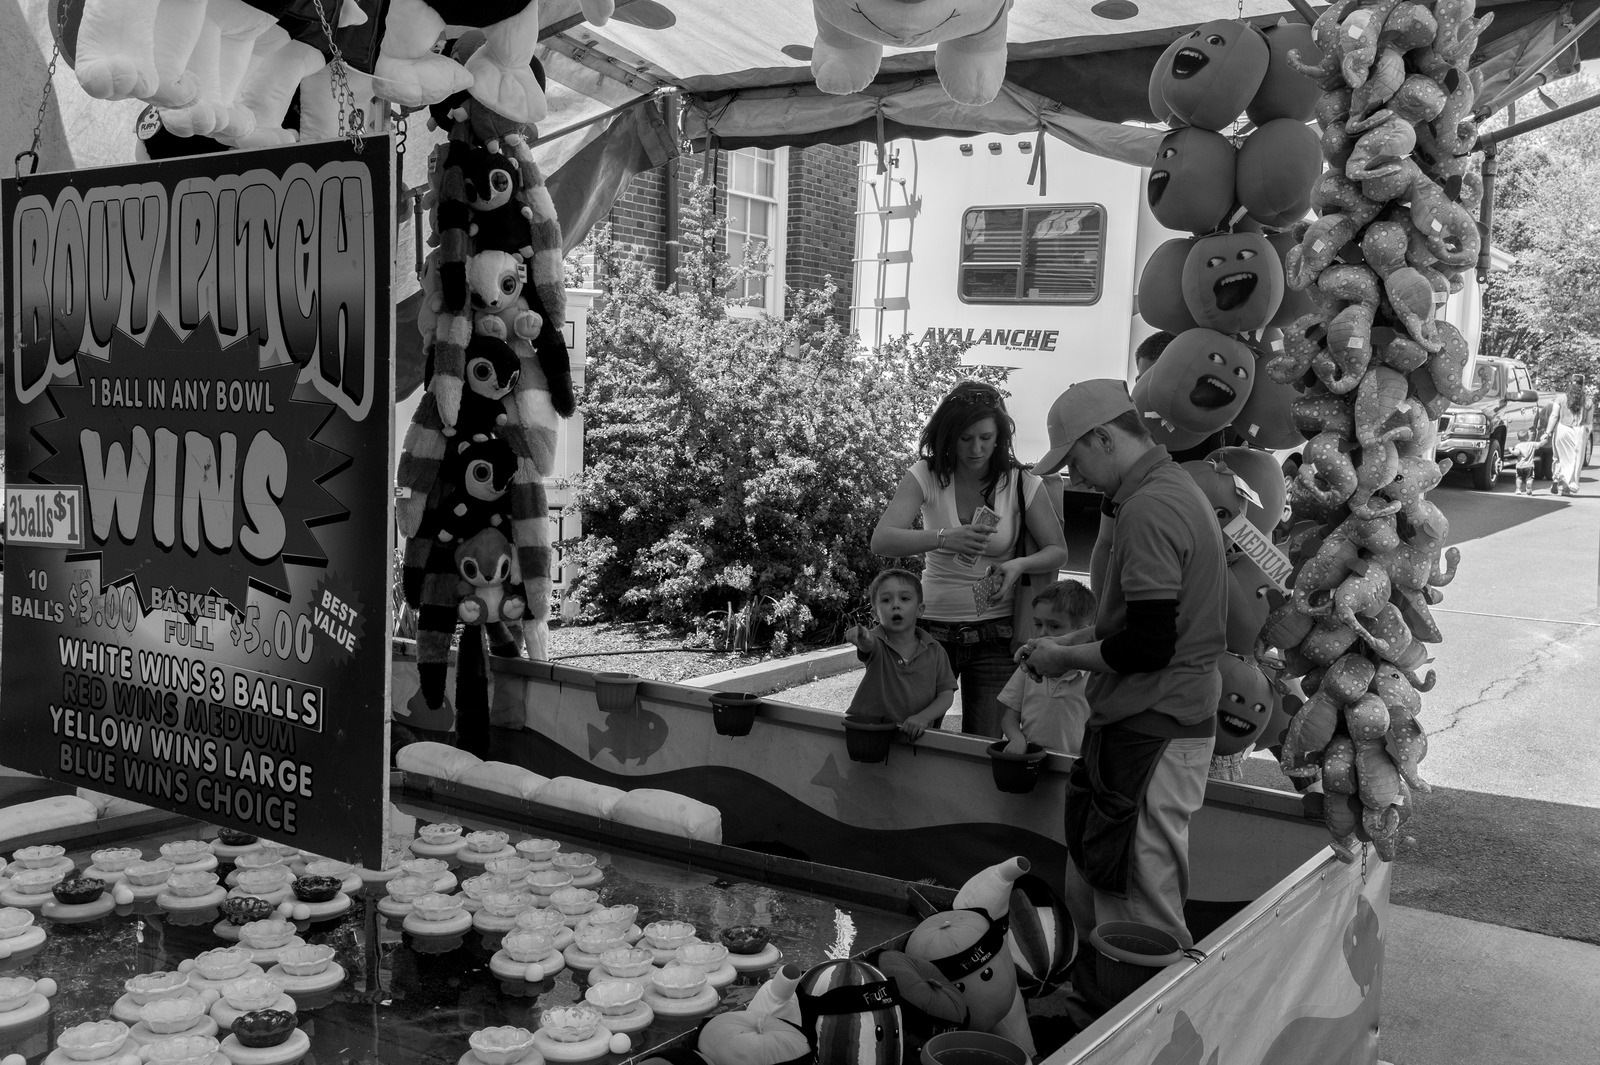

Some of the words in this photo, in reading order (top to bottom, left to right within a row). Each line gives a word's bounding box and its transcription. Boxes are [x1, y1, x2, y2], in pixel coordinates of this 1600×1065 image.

[140, 121, 158, 132] PUPPY
[19, 193, 162, 392] BOUY
[178, 175, 367, 407] PITCH
[918, 327, 1060, 352] AVALANCHE
[89, 378, 97, 407] 1
[101, 377, 143, 408] BALL
[147, 378, 166, 410] IN
[171, 379, 211, 411] ANY
[216, 380, 276, 413] BOWL
[80, 425, 289, 560] WINS
[28, 569, 48, 591] 10
[1231, 523, 1293, 585] MEDIUM
[68, 580, 138, 632] $3.00
[151, 587, 229, 621] BASKET
[313, 606, 357, 653] VALUE
[321, 589, 358, 627] BEST
[164, 619, 215, 651] FULL
[229, 605, 314, 664] $5.00
[58, 635, 133, 680] WHITE
[139, 649, 207, 696] WINS
[209, 667, 226, 703] 3
[232, 672, 318, 726] BALLS
[62, 671, 108, 710] RED
[112, 681, 180, 728] WINS
[183, 696, 297, 756] MEDIUM
[49, 705, 143, 754] YELLOW
[150, 727, 218, 773] WINS
[224, 745, 313, 798] LARGE
[60, 743, 117, 783] BLUE
[123, 757, 190, 803] WINS
[196, 778, 297, 833] CHOICE
